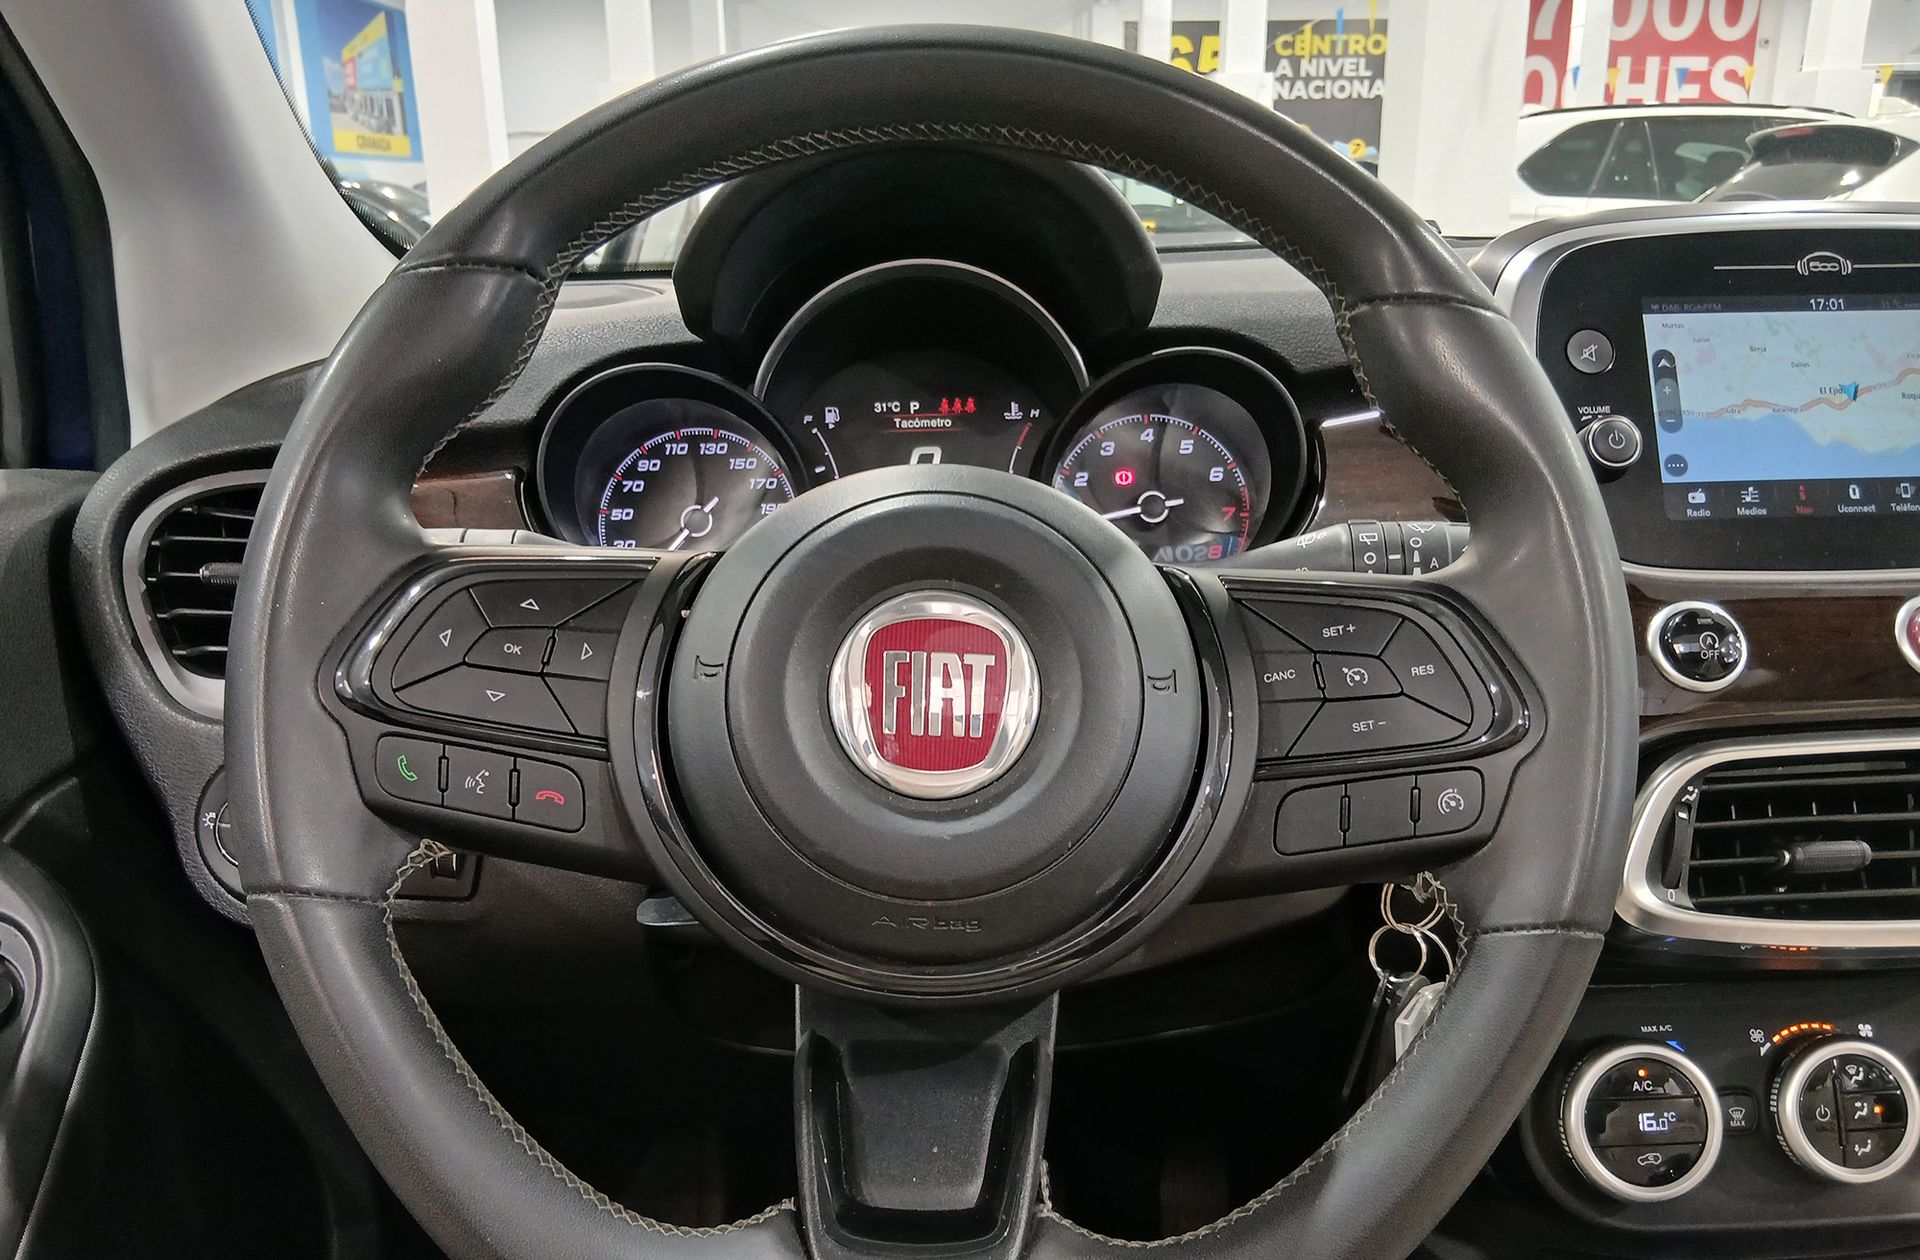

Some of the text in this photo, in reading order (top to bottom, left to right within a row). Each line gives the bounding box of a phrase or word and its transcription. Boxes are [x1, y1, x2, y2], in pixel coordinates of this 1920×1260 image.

[1275, 34, 1388, 56] CENTRO
[1276, 57, 1373, 77] A NIVEL
[1810, 299, 1844, 310] 17:01
[1829, 387, 1846, 397] Ejid
[874, 401, 920, 413] 31°C P
[1577, 405, 1610, 414] VOLUME
[1030, 409, 1040, 418] H
[894, 417, 952, 429] Tacómetro
[1140, 428, 1154, 442] 4
[665, 443, 689, 455] 110
[699, 443, 728, 455] 130
[1100, 441, 1115, 456] 3
[1179, 440, 1194, 454] 5
[637, 459, 661, 471] 90
[729, 458, 757, 470] 150
[1074, 472, 1088, 487] 2
[1209, 467, 1224, 482] 6
[622, 480, 644, 493] 70
[750, 478, 778, 489] 170
[1222, 507, 1236, 521] 7
[1687, 508, 1711, 517] Radio
[1737, 506, 1767, 516] Medios
[1838, 503, 1876, 513] Uconnect
[610, 508, 634, 521] 50
[1430, 557, 1439, 568] A
[503, 643, 522, 655] OK
[1700, 650, 1719, 660] OFF
[1263, 669, 1296, 683] CANC
[1411, 664, 1435, 677] RES
[882, 650, 995, 738] FIAT
[1632, 1080, 1653, 1092] A/C
